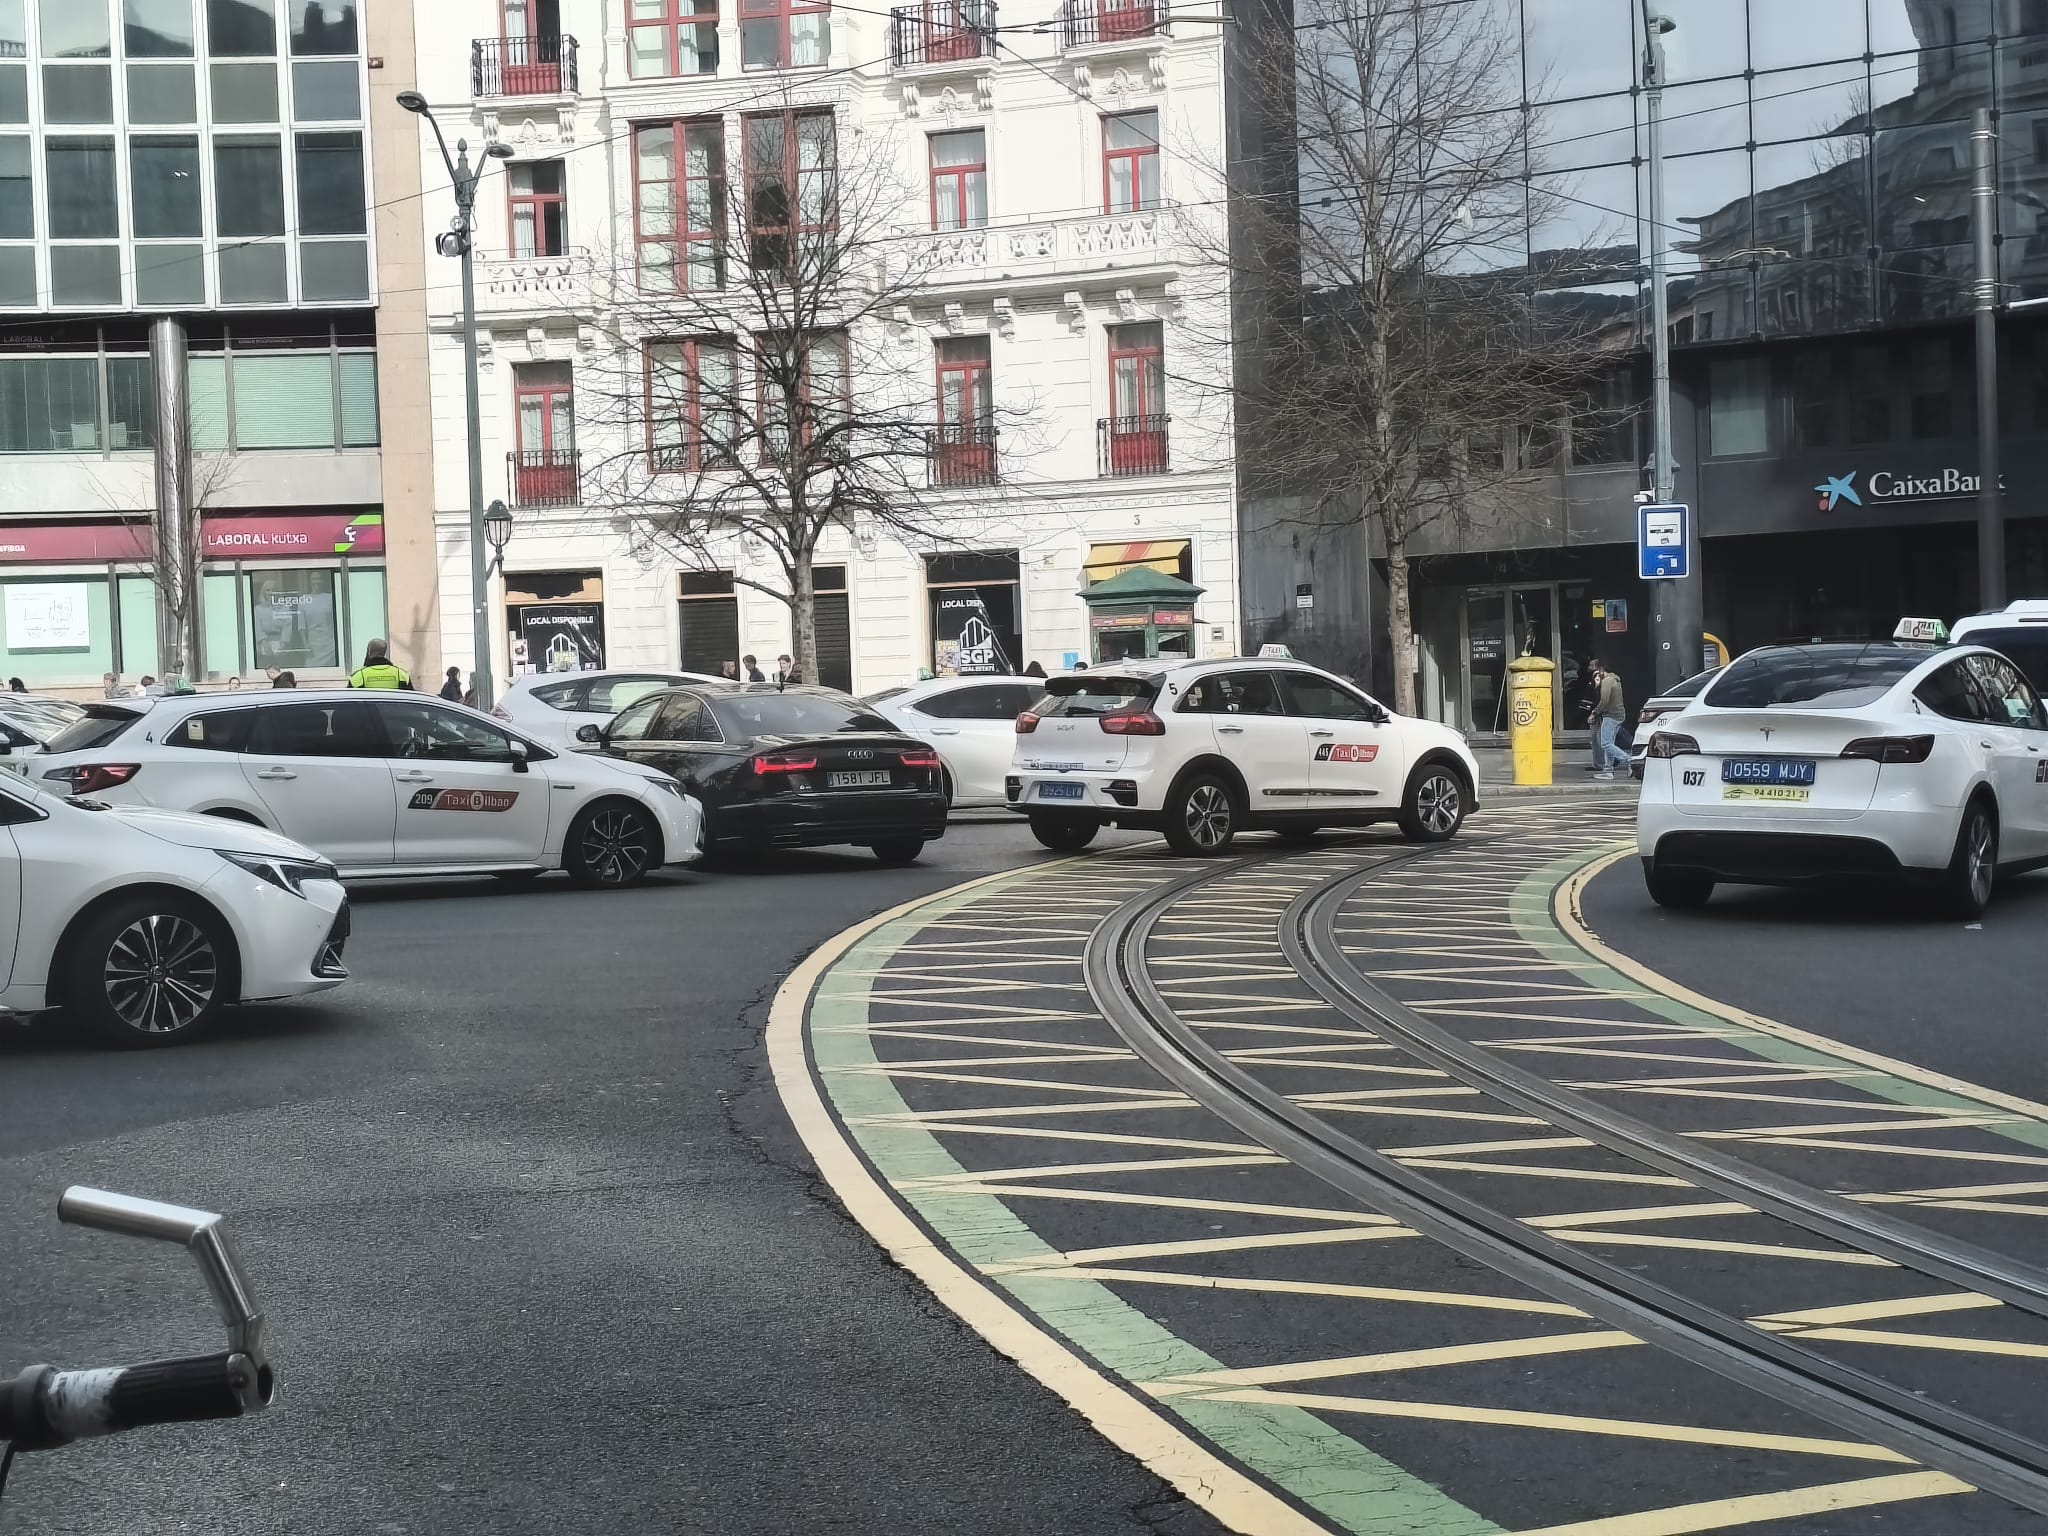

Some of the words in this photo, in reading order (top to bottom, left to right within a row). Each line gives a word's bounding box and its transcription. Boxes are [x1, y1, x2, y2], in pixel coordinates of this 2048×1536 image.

[1869, 468, 2006, 498] CaixaBa
[1134, 514, 1140, 525] 3
[208, 534, 269, 546] LABORAL
[271, 533, 307, 544] kutxa
[271, 594, 312, 607] Legado
[941, 600, 965, 609] LOCAL
[527, 616, 551, 625] LOCAL
[960, 649, 994, 664] SGP
[1168, 683, 1178, 695] 5
[145, 731, 153, 743] 4
[1734, 763, 1770, 777] 0559
[1778, 763, 1808, 779] MJY
[836, 772, 863, 785] 1581
[868, 771, 889, 784] JFL
[1683, 770, 1705, 787] 037
[415, 793, 433, 804] 209
[1754, 788, 1764, 796] 94
[1766, 789, 1783, 797] 410
[1799, 790, 1809, 798] 21
